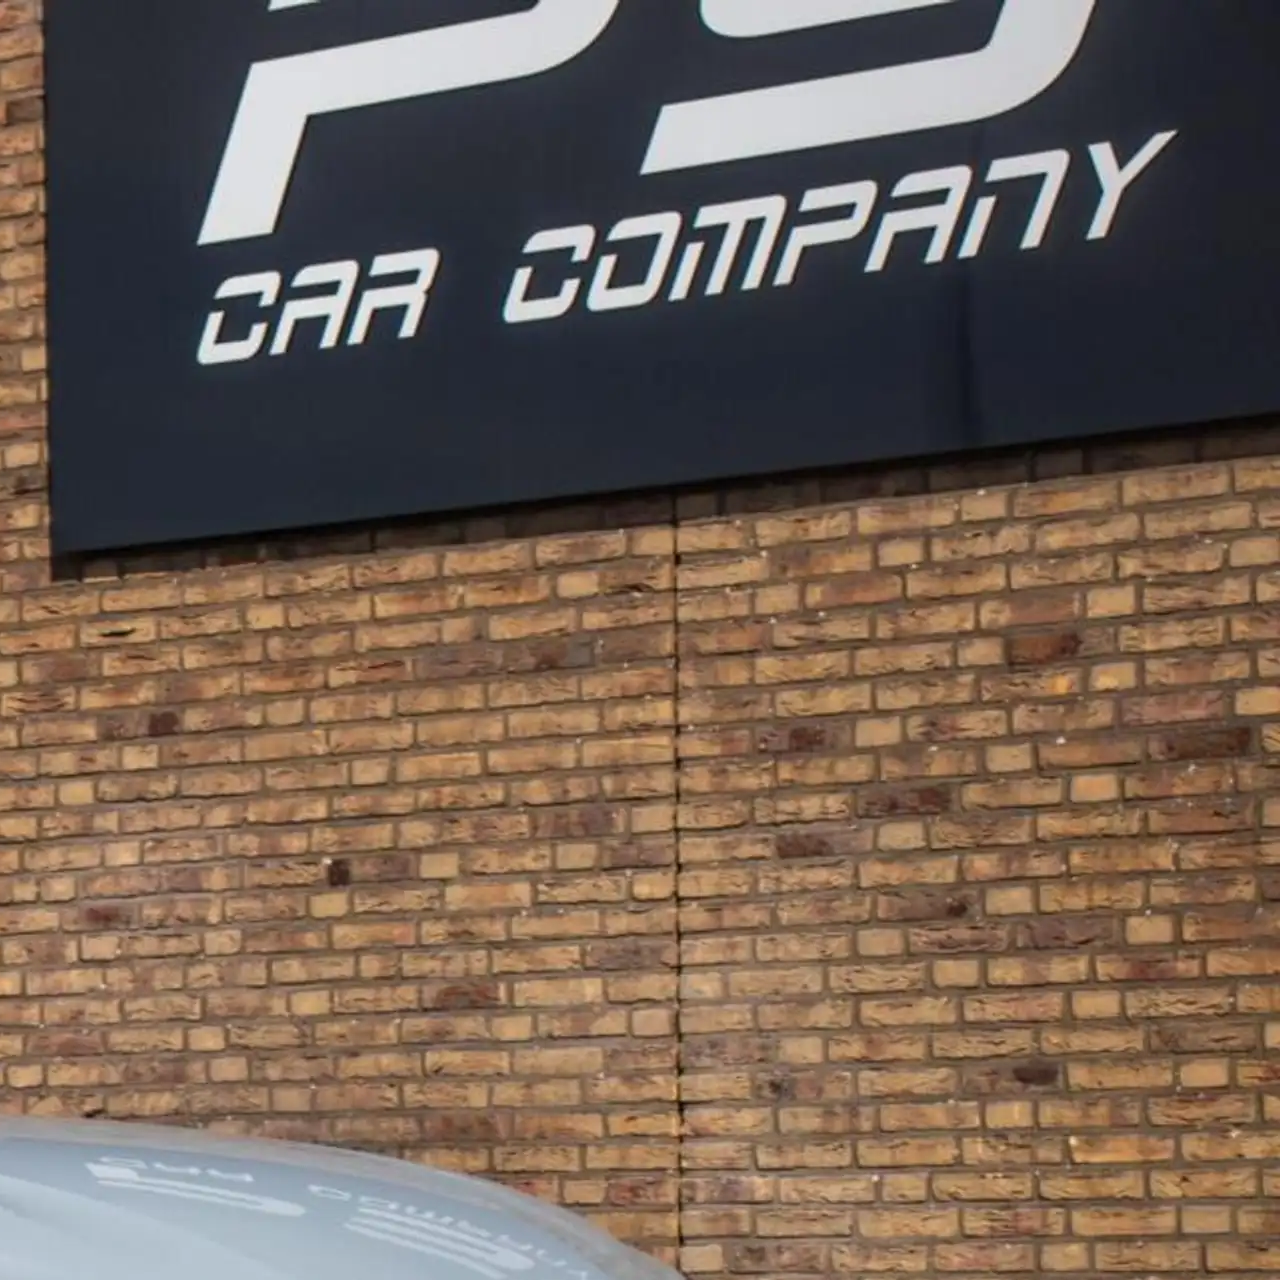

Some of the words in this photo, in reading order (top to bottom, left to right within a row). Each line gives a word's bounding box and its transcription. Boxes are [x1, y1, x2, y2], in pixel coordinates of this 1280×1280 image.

[198, 0, 1095, 245] PS
[197, 248, 440, 366] CAR
[503, 130, 1176, 324] COMPANY
